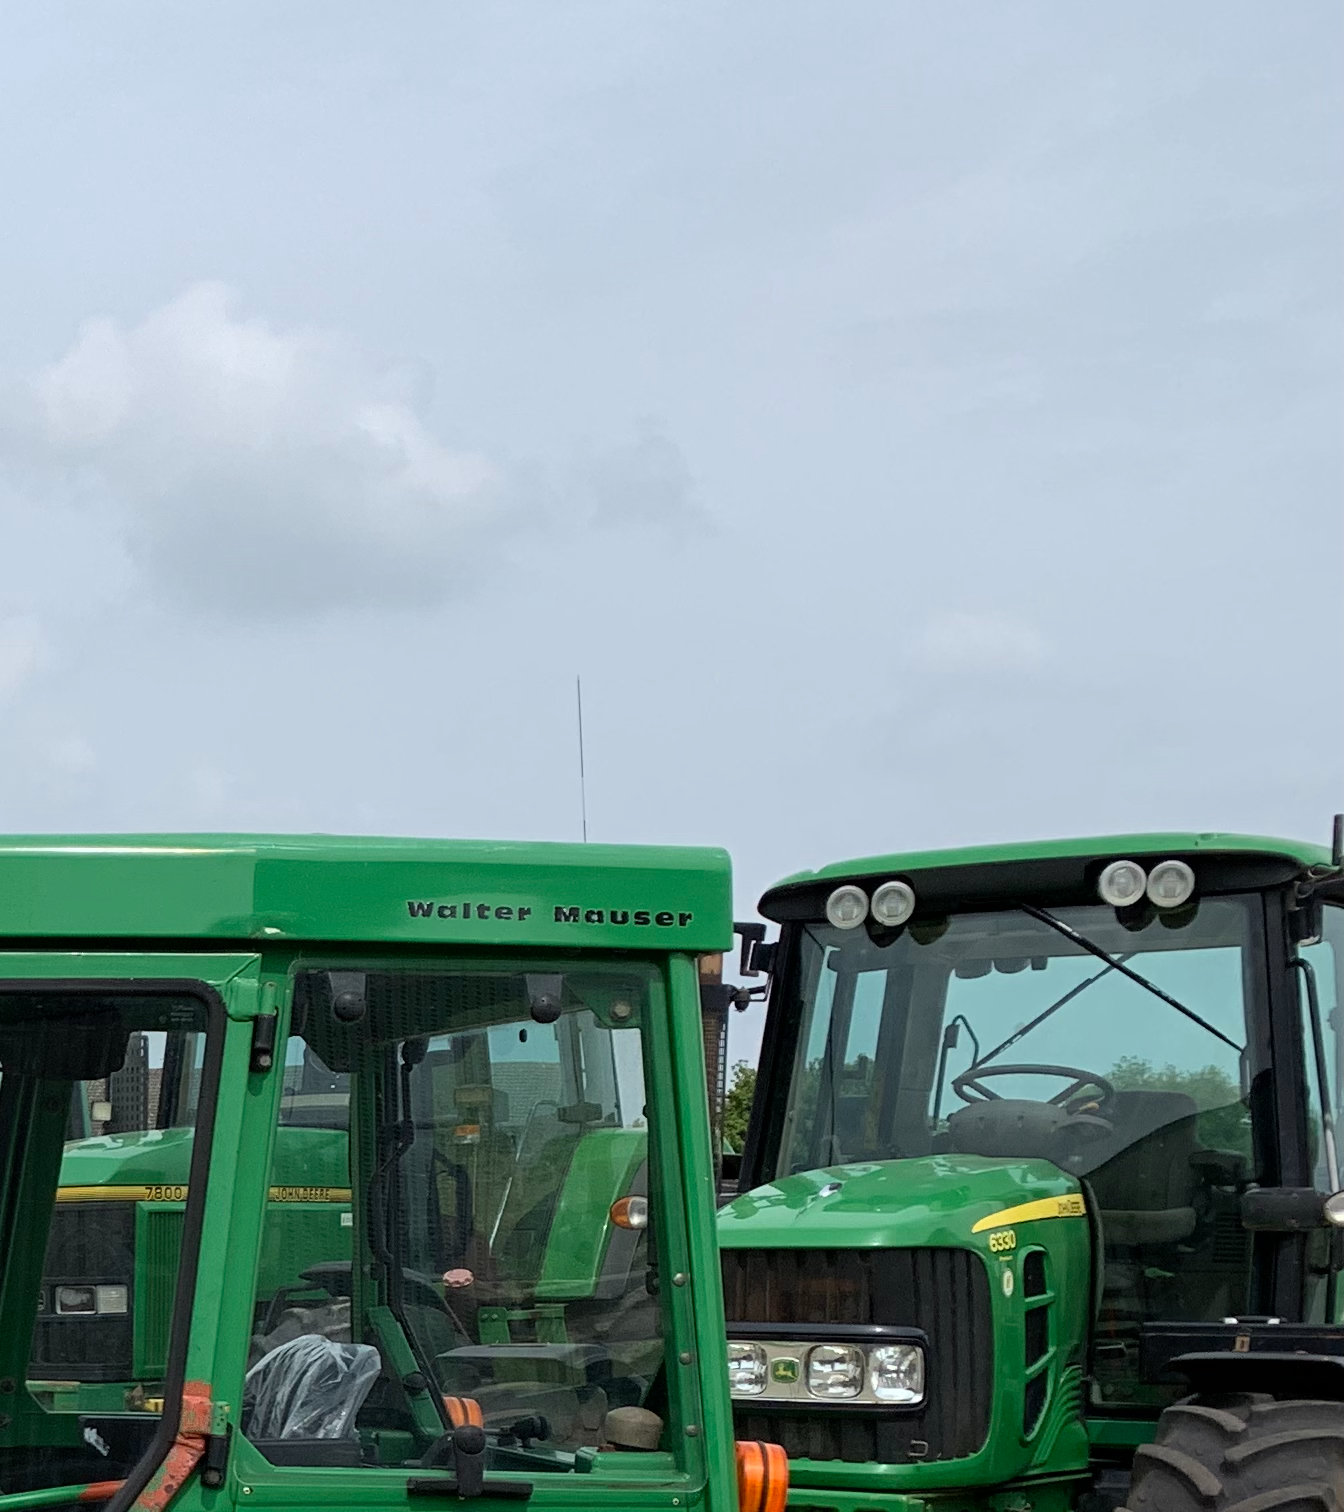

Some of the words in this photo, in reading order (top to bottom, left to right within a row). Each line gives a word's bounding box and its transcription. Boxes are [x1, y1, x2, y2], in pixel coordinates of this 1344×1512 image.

[407, 900, 532, 922] Walter
[554, 905, 693, 928] Mauser
[144, 1186, 182, 1199] 7800
[275, 1187, 300, 1200] JOHN
[303, 1188, 330, 1200] DEERE
[989, 1230, 1016, 1252] 6330
